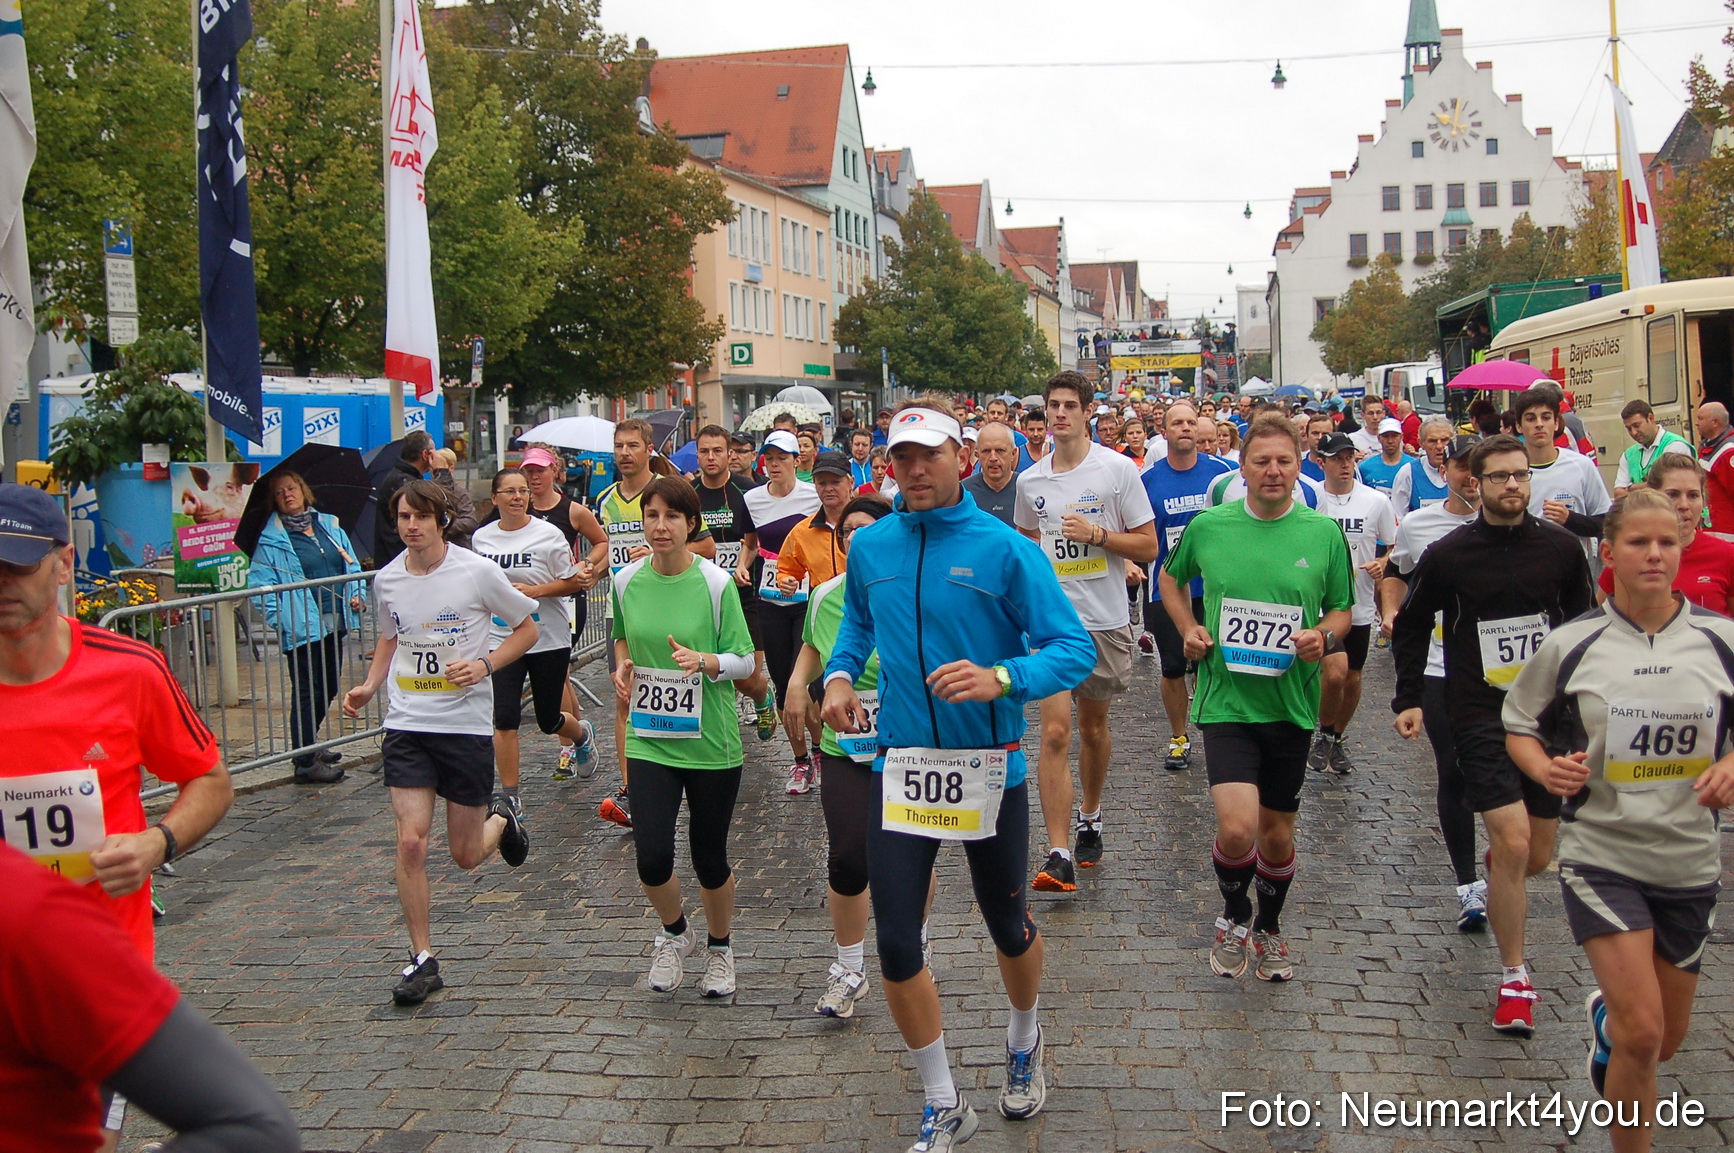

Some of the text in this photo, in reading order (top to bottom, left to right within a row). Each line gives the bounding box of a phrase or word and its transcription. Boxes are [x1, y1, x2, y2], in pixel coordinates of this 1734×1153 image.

[734, 346, 750, 362] D
[1570, 336, 1620, 365] Bayerisches
[1140, 358, 1170, 366] START
[1570, 367, 1593, 386] Rotes
[1572, 391, 1592, 409] reuz
[1223, 606, 1288, 619] PARTL Neumarkt
[1226, 617, 1292, 650] 2872
[1480, 626, 1506, 636] PARTL
[1498, 632, 1544, 662] 576
[412, 652, 440, 674] 78
[1232, 650, 1280, 668] Wolfgang
[634, 672, 689, 684] PARTL Neumarkt
[1634, 666, 1673, 676] saller
[414, 680, 442, 690] Stefen
[637, 684, 694, 713] 2834
[1611, 707, 1703, 720] PARTL Neumarkt
[650, 718, 674, 729] Silke
[1629, 724, 1698, 756] 469
[887, 756, 966, 767] PARTL Neumarkt
[1633, 764, 1684, 778] Claudia
[4, 786, 73, 802] Neumarkt
[904, 770, 963, 804] 508
[905, 808, 958, 826] Thorsten
[0, 804, 75, 850] 19
